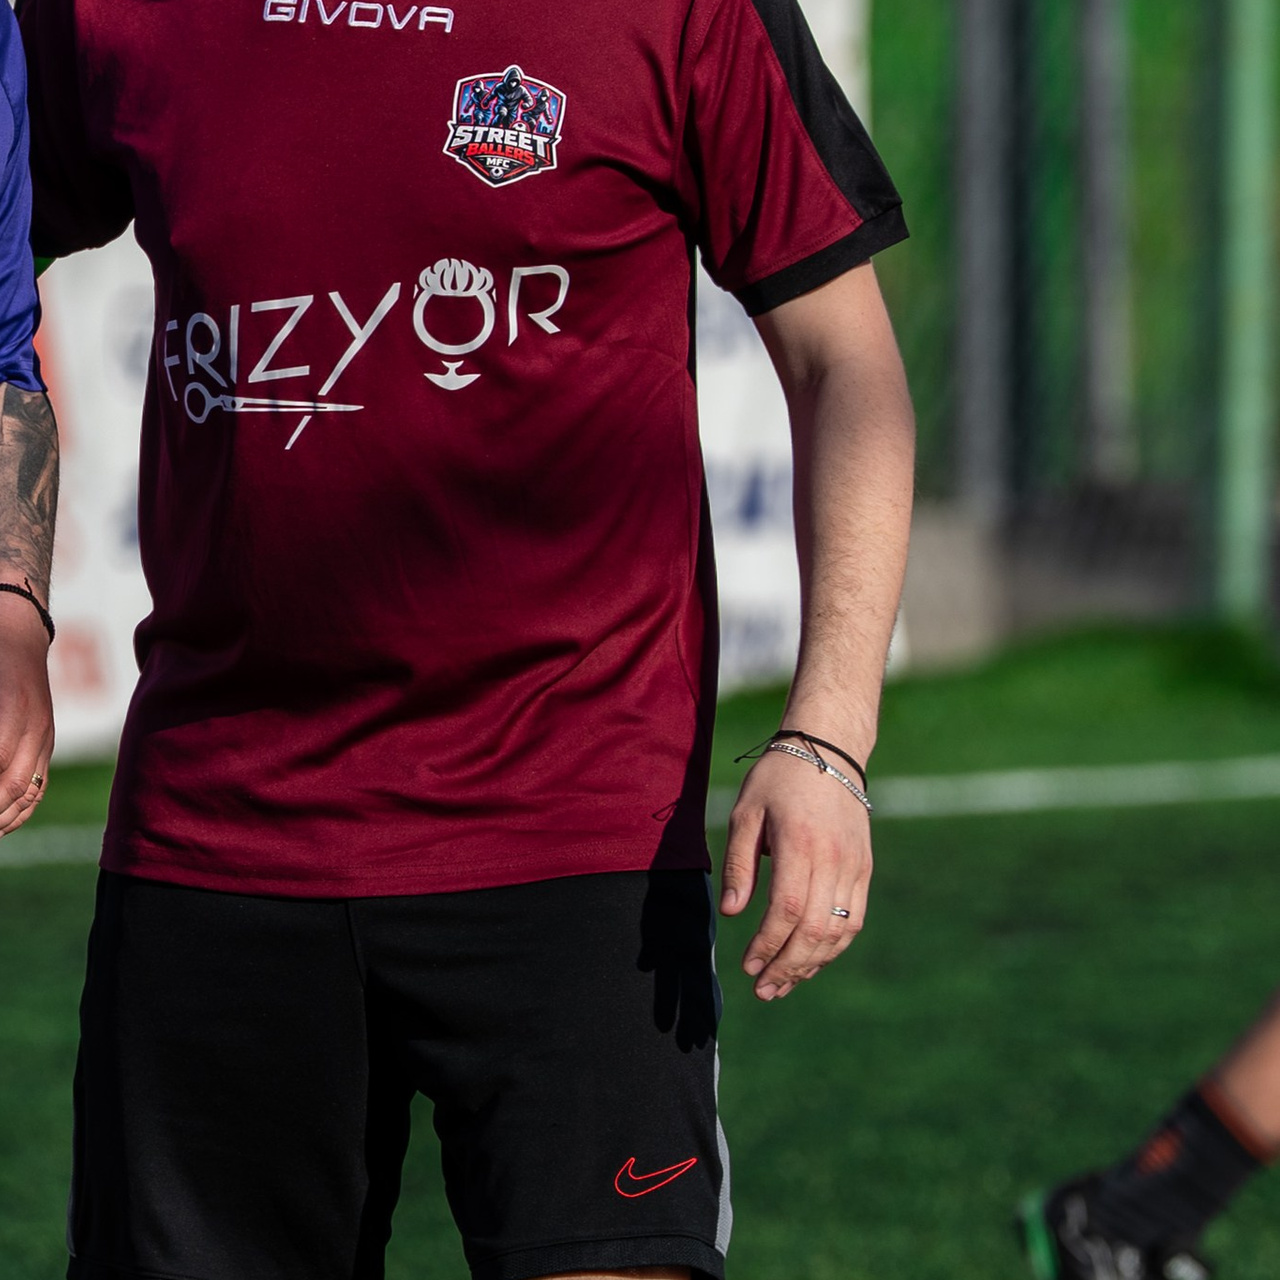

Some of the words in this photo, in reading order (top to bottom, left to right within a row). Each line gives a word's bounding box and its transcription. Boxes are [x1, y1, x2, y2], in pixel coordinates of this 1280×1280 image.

[450, 124, 550, 158] STREET
[466, 142, 536, 166] BALLERS
[486, 157, 511, 168] MFC
